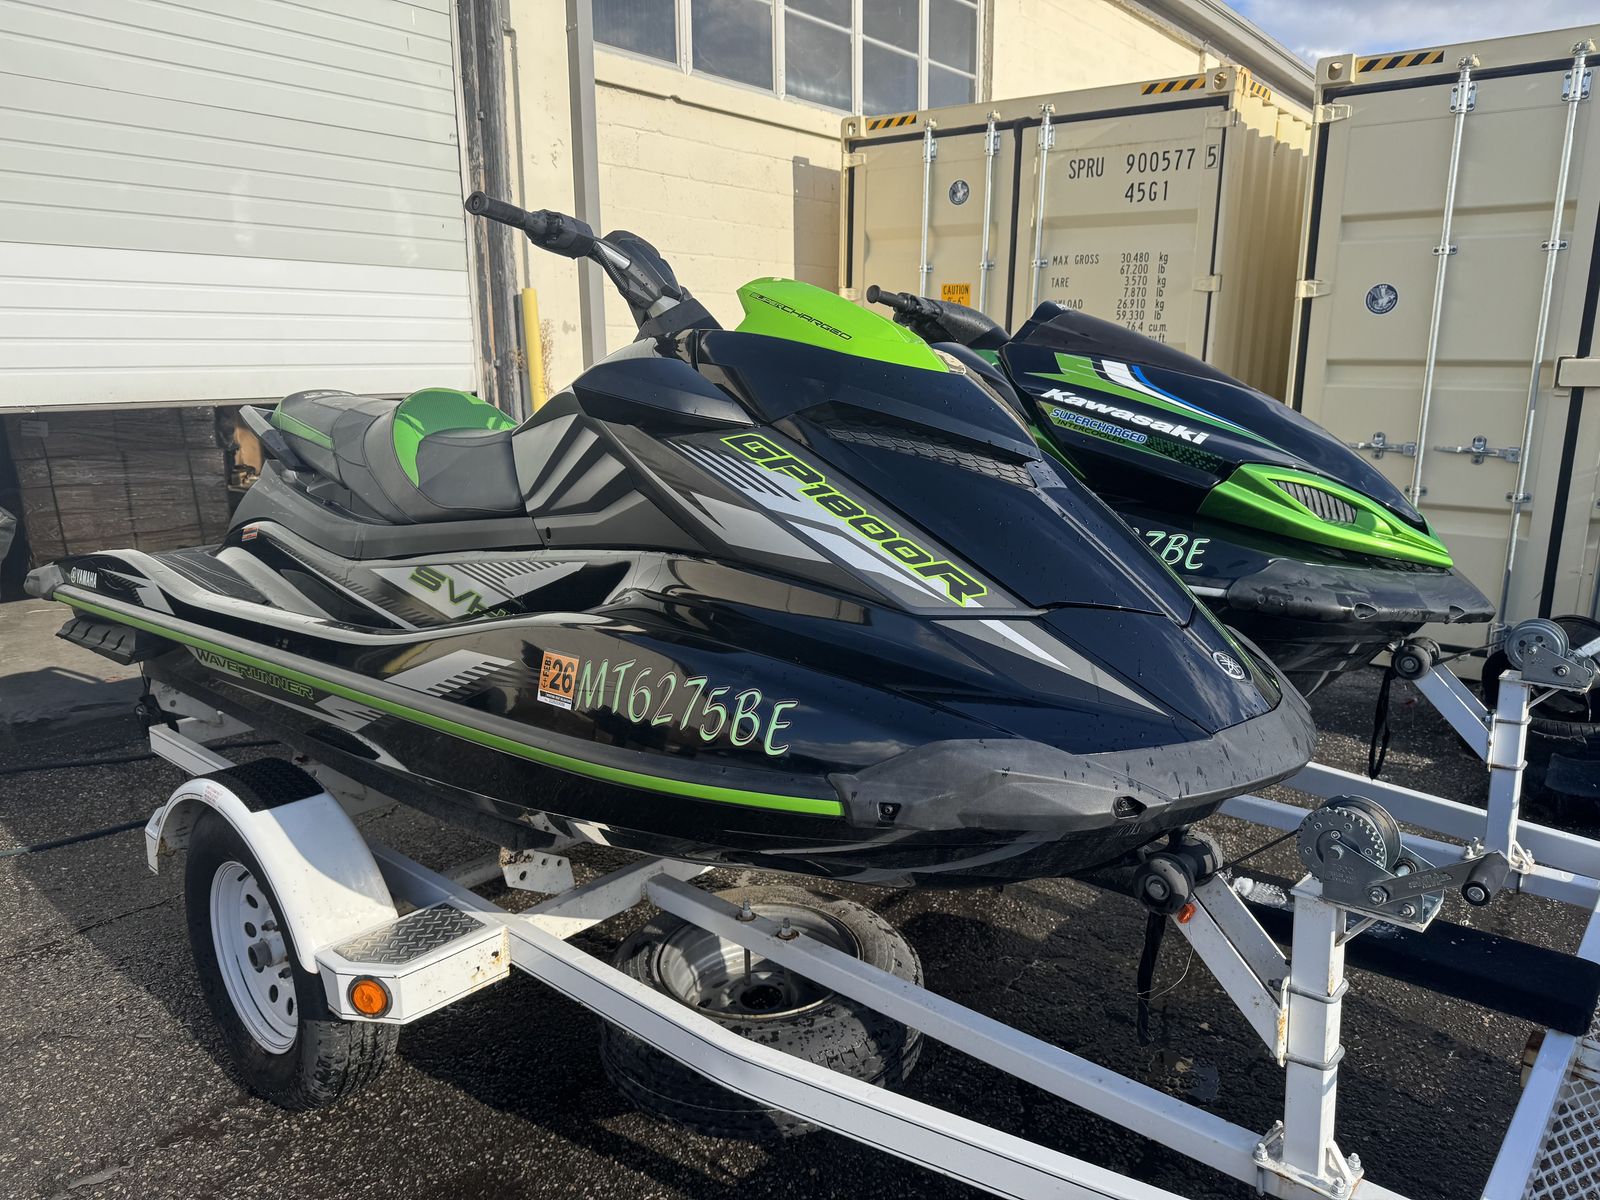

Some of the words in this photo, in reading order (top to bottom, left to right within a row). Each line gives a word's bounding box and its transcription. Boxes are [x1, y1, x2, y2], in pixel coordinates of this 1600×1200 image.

[1068, 156, 1105, 180] SPRU
[1126, 148, 1196, 174] 900577
[1206, 145, 1218, 168] 5
[1124, 180, 1169, 203] 45G1
[1052, 255, 1069, 266] MAX
[1074, 254, 1100, 265] GROSS
[1120, 252, 1149, 264] 30.480
[1159, 251, 1169, 265] kg
[1120, 263, 1149, 275] 67.200
[1157, 263, 1166, 274] lb
[943, 284, 969, 295] CAUTION
[1051, 277, 1070, 288] TARE
[1124, 275, 1148, 286] 3.570
[1157, 275, 1167, 288] kg
[1123, 286, 1147, 298] 7.870
[1156, 286, 1164, 297] lb
[749, 291, 853, 341] SUPERCHARGED
[1115, 309, 1145, 320] 59.330
[1153, 309, 1162, 320] lb
[1116, 298, 1146, 309] 26.910
[1154, 298, 1165, 312] kg
[1040, 388, 1211, 445] Kawasaki
[1051, 408, 1148, 444] SUPERCHARGED
[1056, 419, 1126, 444] INTERCOOLED
[719, 433, 988, 608] GP1800R
[1132, 527, 1211, 570] 7BE
[76, 568, 98, 589] YAMAHA
[542, 658, 552, 678] FEB
[549, 658, 575, 693] 26
